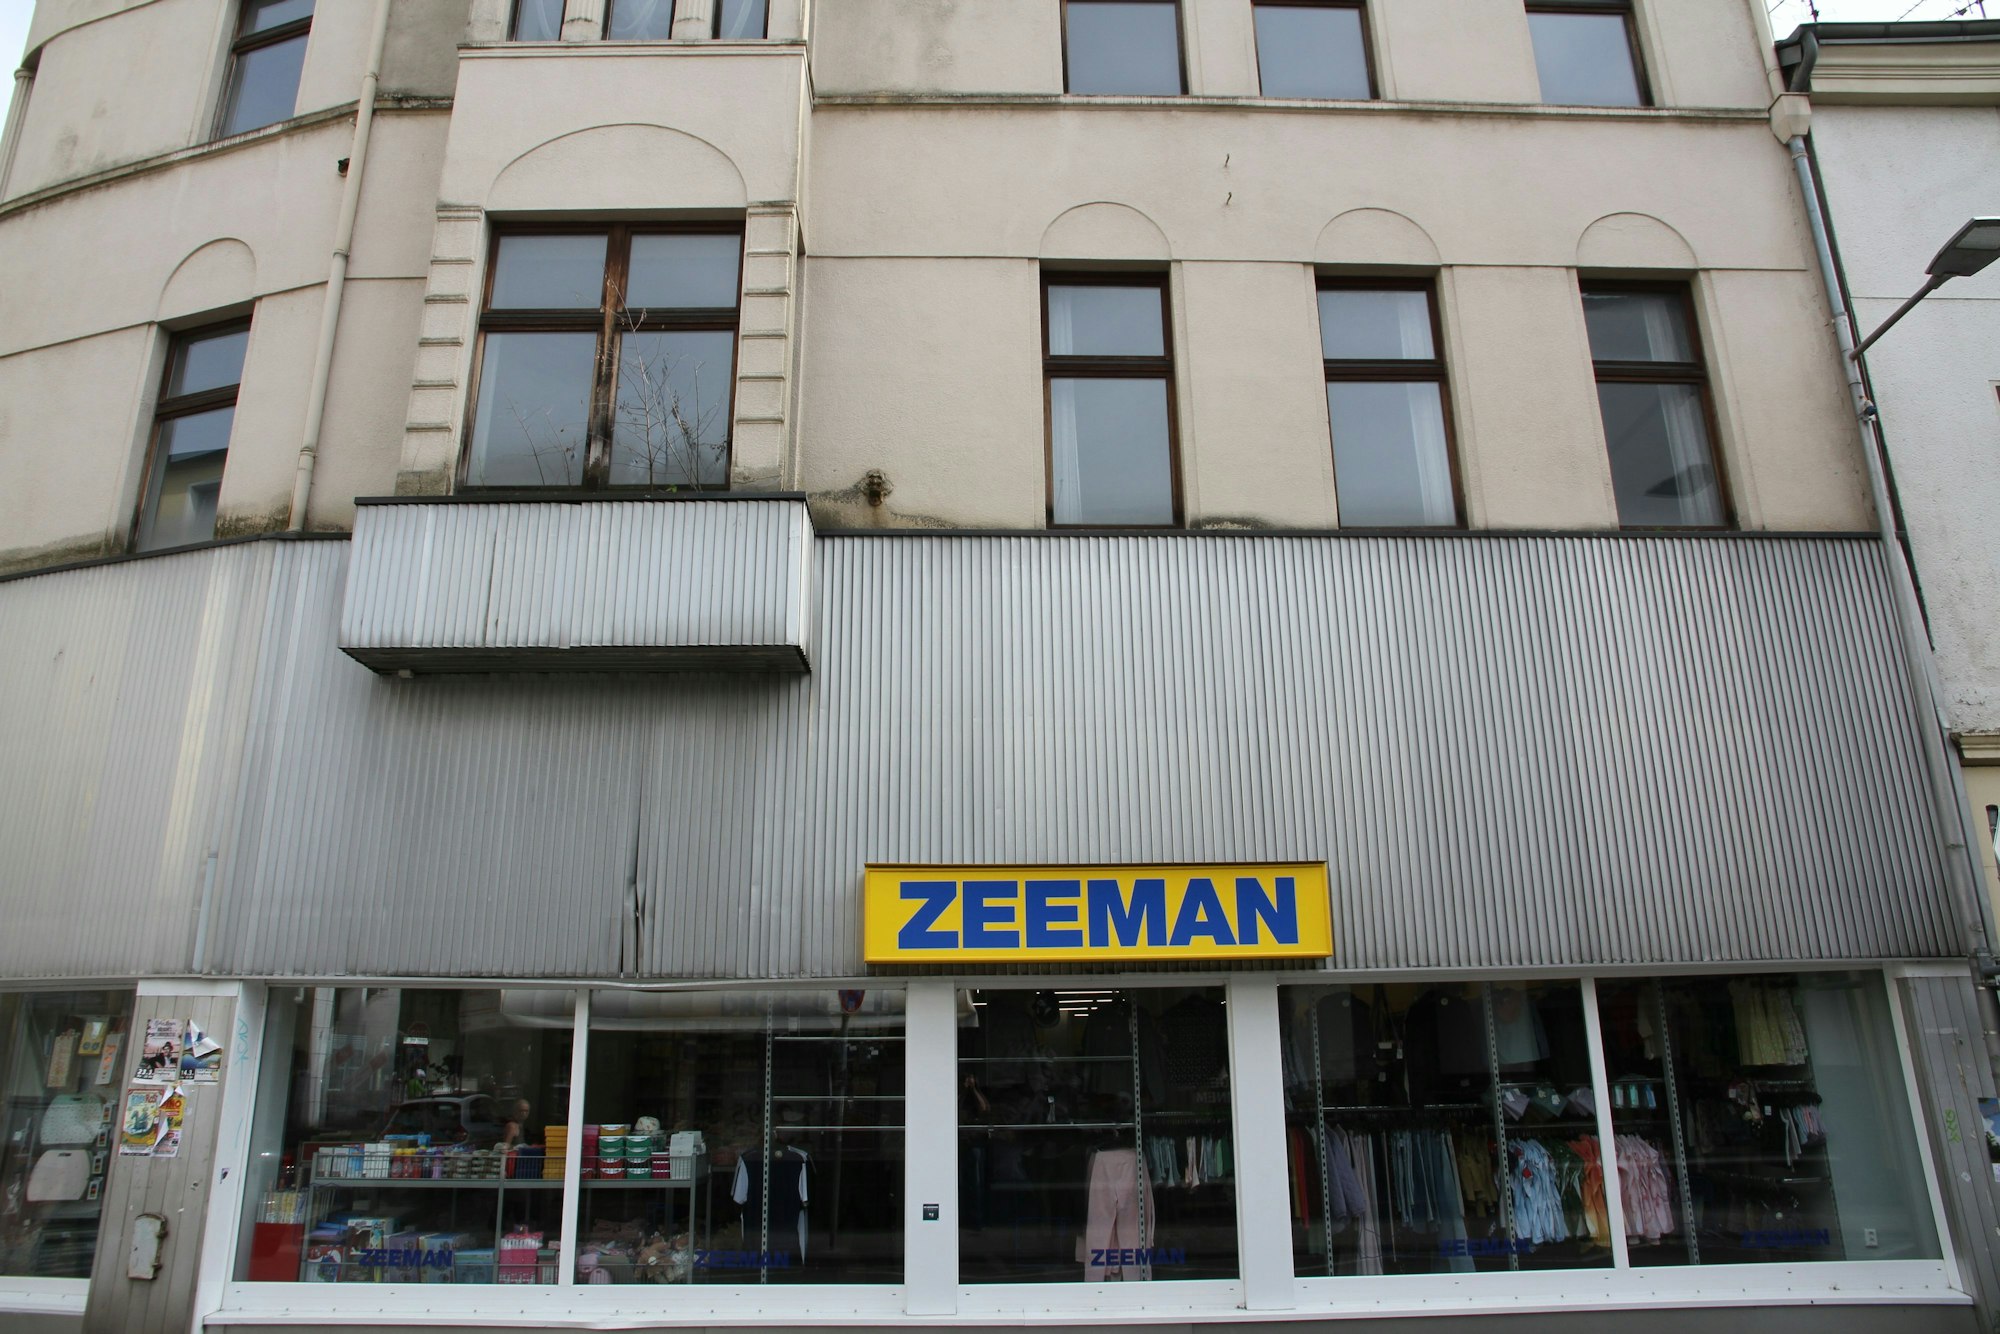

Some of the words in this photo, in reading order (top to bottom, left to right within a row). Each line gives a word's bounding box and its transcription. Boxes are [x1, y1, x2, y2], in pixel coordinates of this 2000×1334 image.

[898, 877, 1298, 949] ZEEMAN
[1440, 1238, 1532, 1257] ZEEMAN
[359, 1249, 453, 1266] ZEEMAN
[694, 1250, 789, 1268] ZEEMAN
[1091, 1248, 1185, 1266] ZEEMAN
